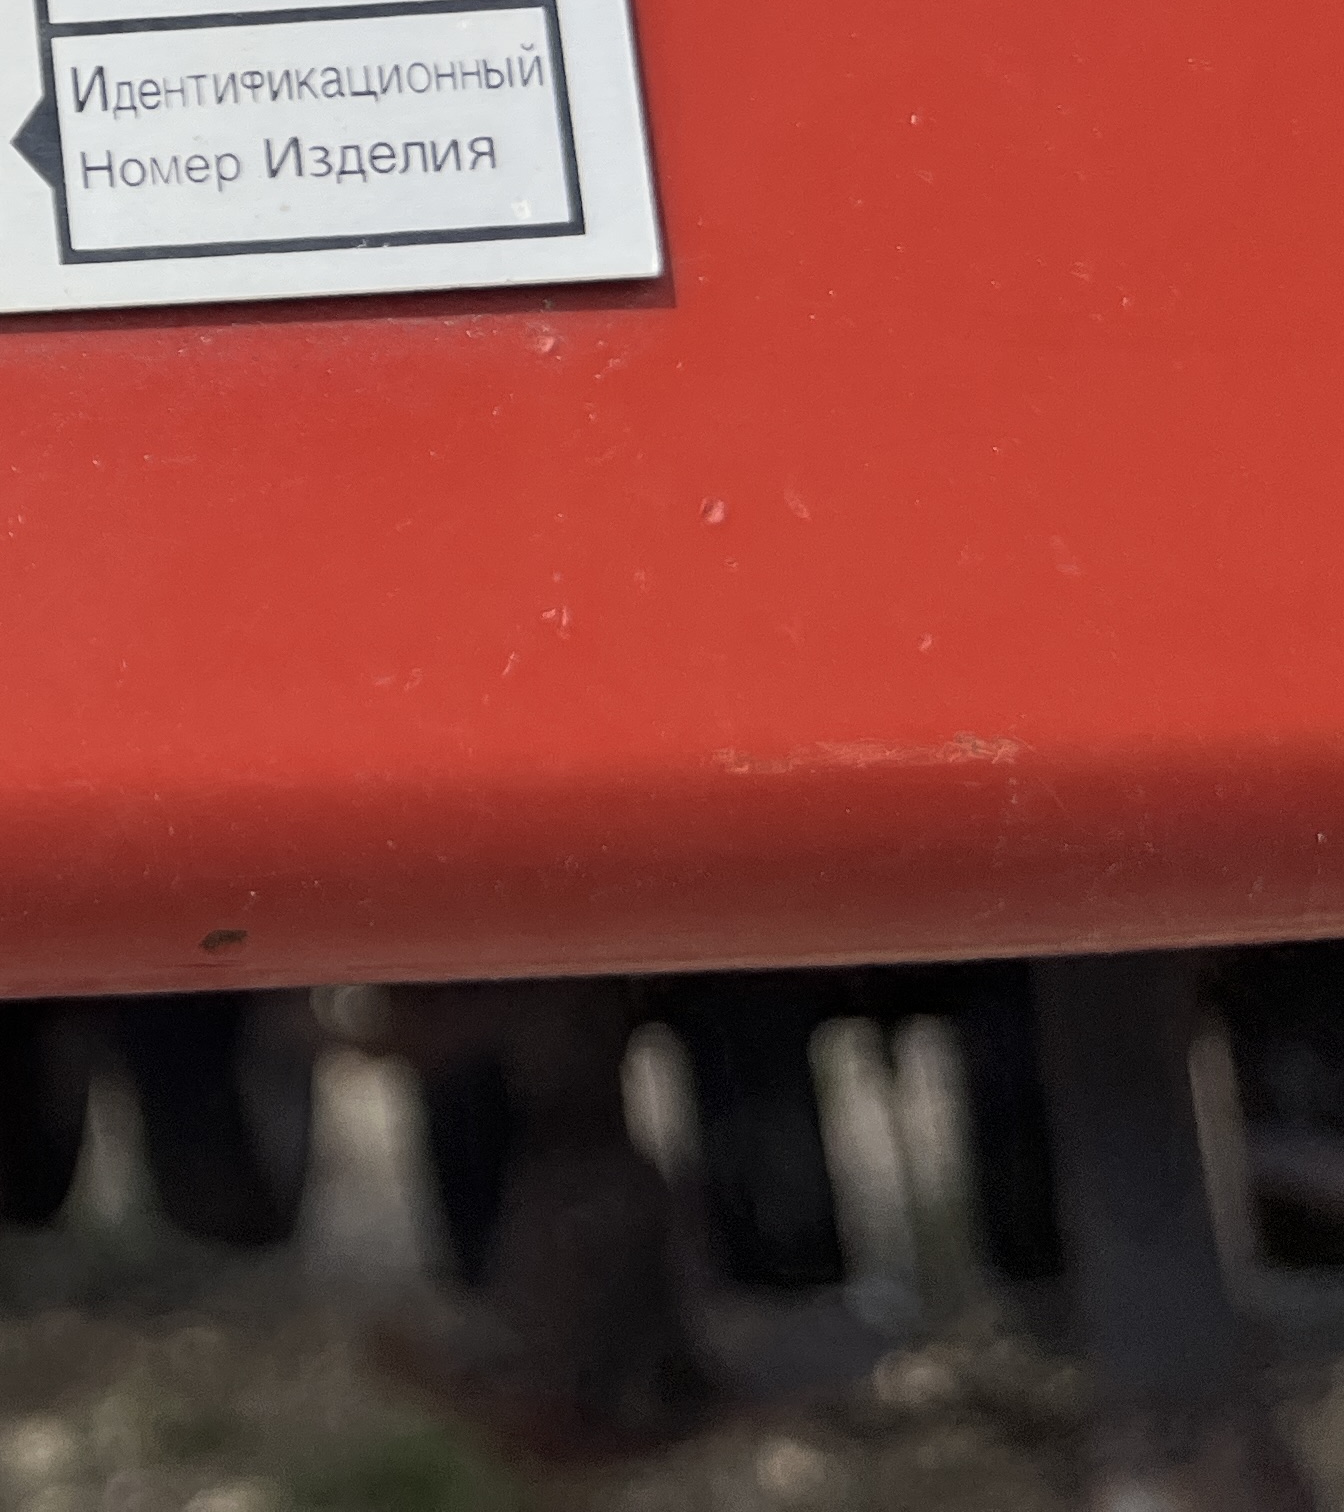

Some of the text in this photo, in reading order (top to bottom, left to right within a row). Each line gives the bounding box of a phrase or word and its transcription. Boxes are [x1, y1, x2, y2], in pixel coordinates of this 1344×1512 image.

[70, 42, 546, 119] Идентификационный
[79, 135, 498, 192] Номер Изделия
